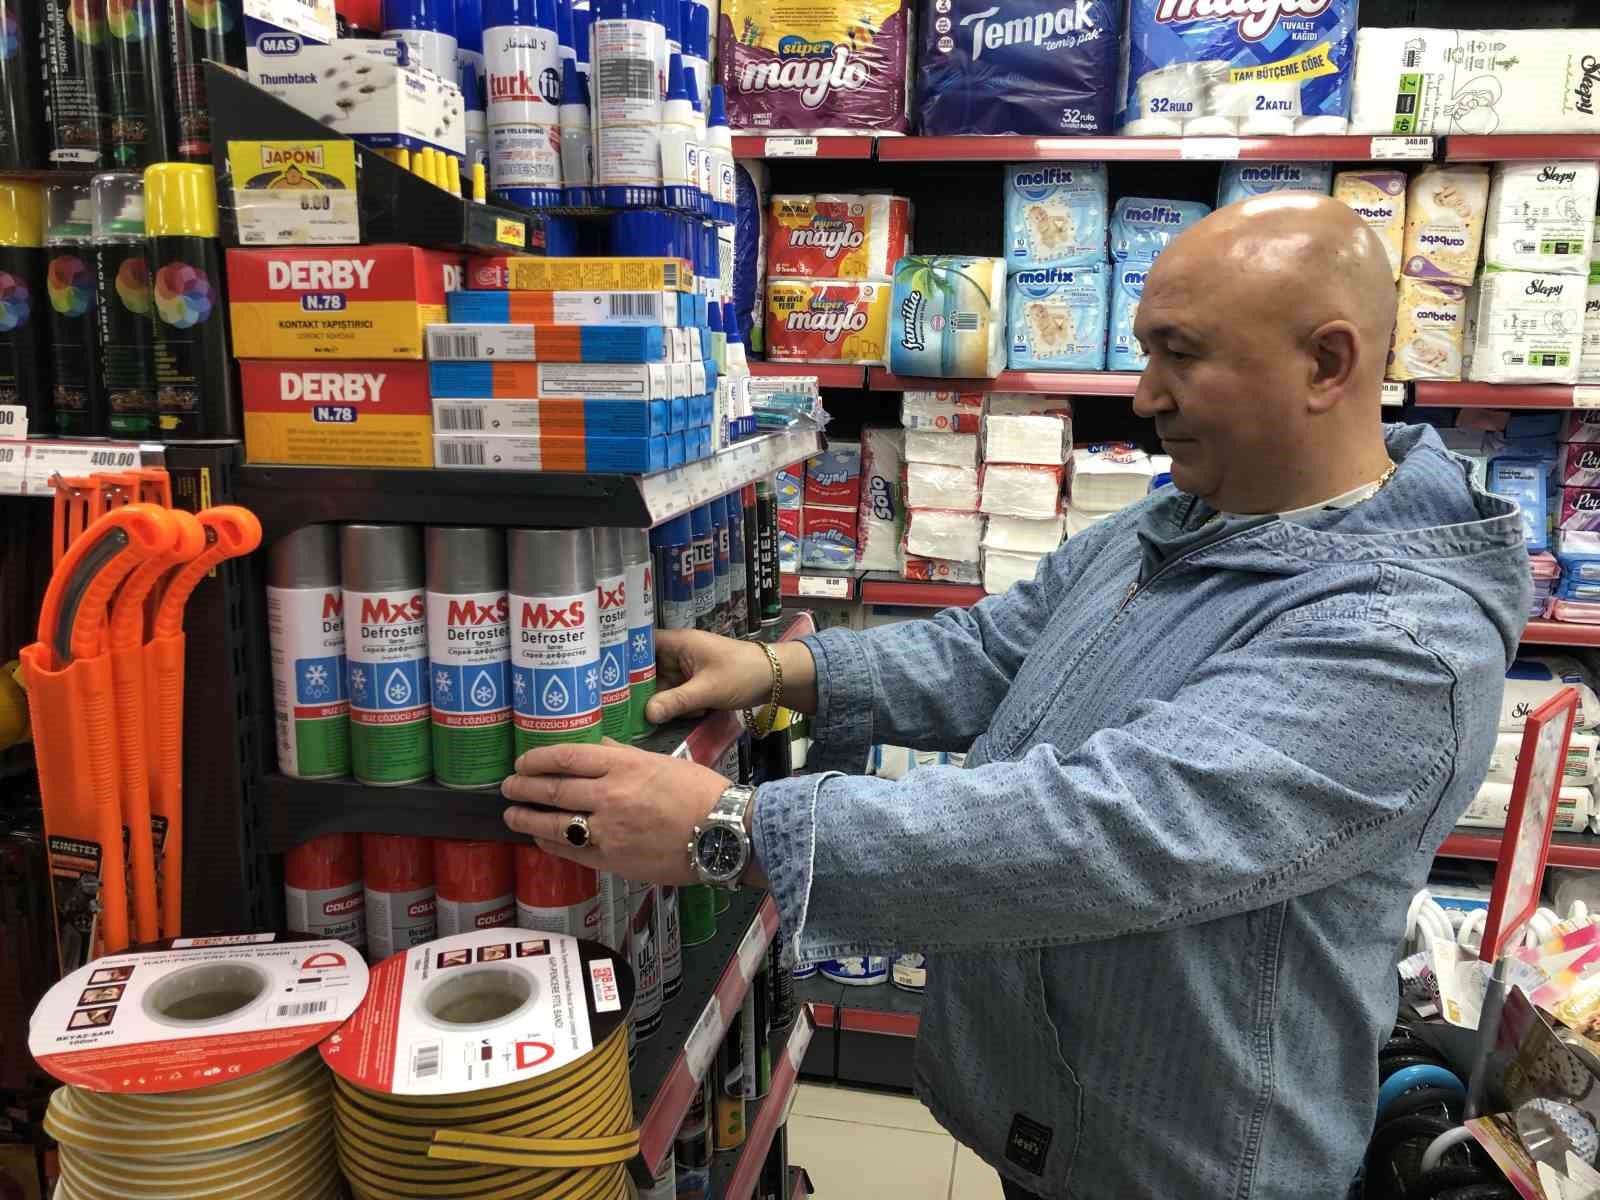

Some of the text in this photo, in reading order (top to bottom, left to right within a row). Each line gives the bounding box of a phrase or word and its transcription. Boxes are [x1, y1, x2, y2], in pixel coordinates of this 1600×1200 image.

[960, 0, 1094, 61] Tempak
[1282, 22, 1314, 31] TUVALET
[1292, 31, 1317, 41] KAĞIDI
[263, 40, 296, 51] MAS
[783, 41, 830, 56] süper
[742, 46, 867, 107] maylo
[1234, 54, 1325, 82] TAM BÜTÇEME GÖRE
[260, 73, 317, 84] Thumbtack
[490, 71, 533, 95] turk
[1016, 169, 1072, 186] molfix
[1242, 164, 1301, 180] molfix
[1537, 166, 1576, 183] Sleepy
[1125, 207, 1181, 224] molfix
[790, 223, 863, 257] maylo
[1420, 235, 1464, 246] canbebe
[268, 260, 375, 290] DERBY
[1018, 269, 1074, 284] molfix
[1525, 280, 1563, 297] Sleepy
[306, 295, 341, 309] N.78
[788, 305, 867, 341] maylo
[903, 291, 921, 350] familia
[1417, 310, 1456, 322] canbebe
[279, 321, 319, 329] KONTAKT
[280, 373, 387, 402] DERBY
[317, 407, 353, 421] N.78
[91, 452, 135, 467] 400.00
[871, 476, 894, 521] solo
[761, 525, 773, 590] STEEL
[361, 594, 425, 625] MxS
[448, 597, 509, 625] MxS
[521, 600, 584, 629] MxS
[521, 631, 585, 645] Defroster
[536, 719, 568, 731] ÇÖZÜCÜ
[51, 840, 98, 856] KINETEX
